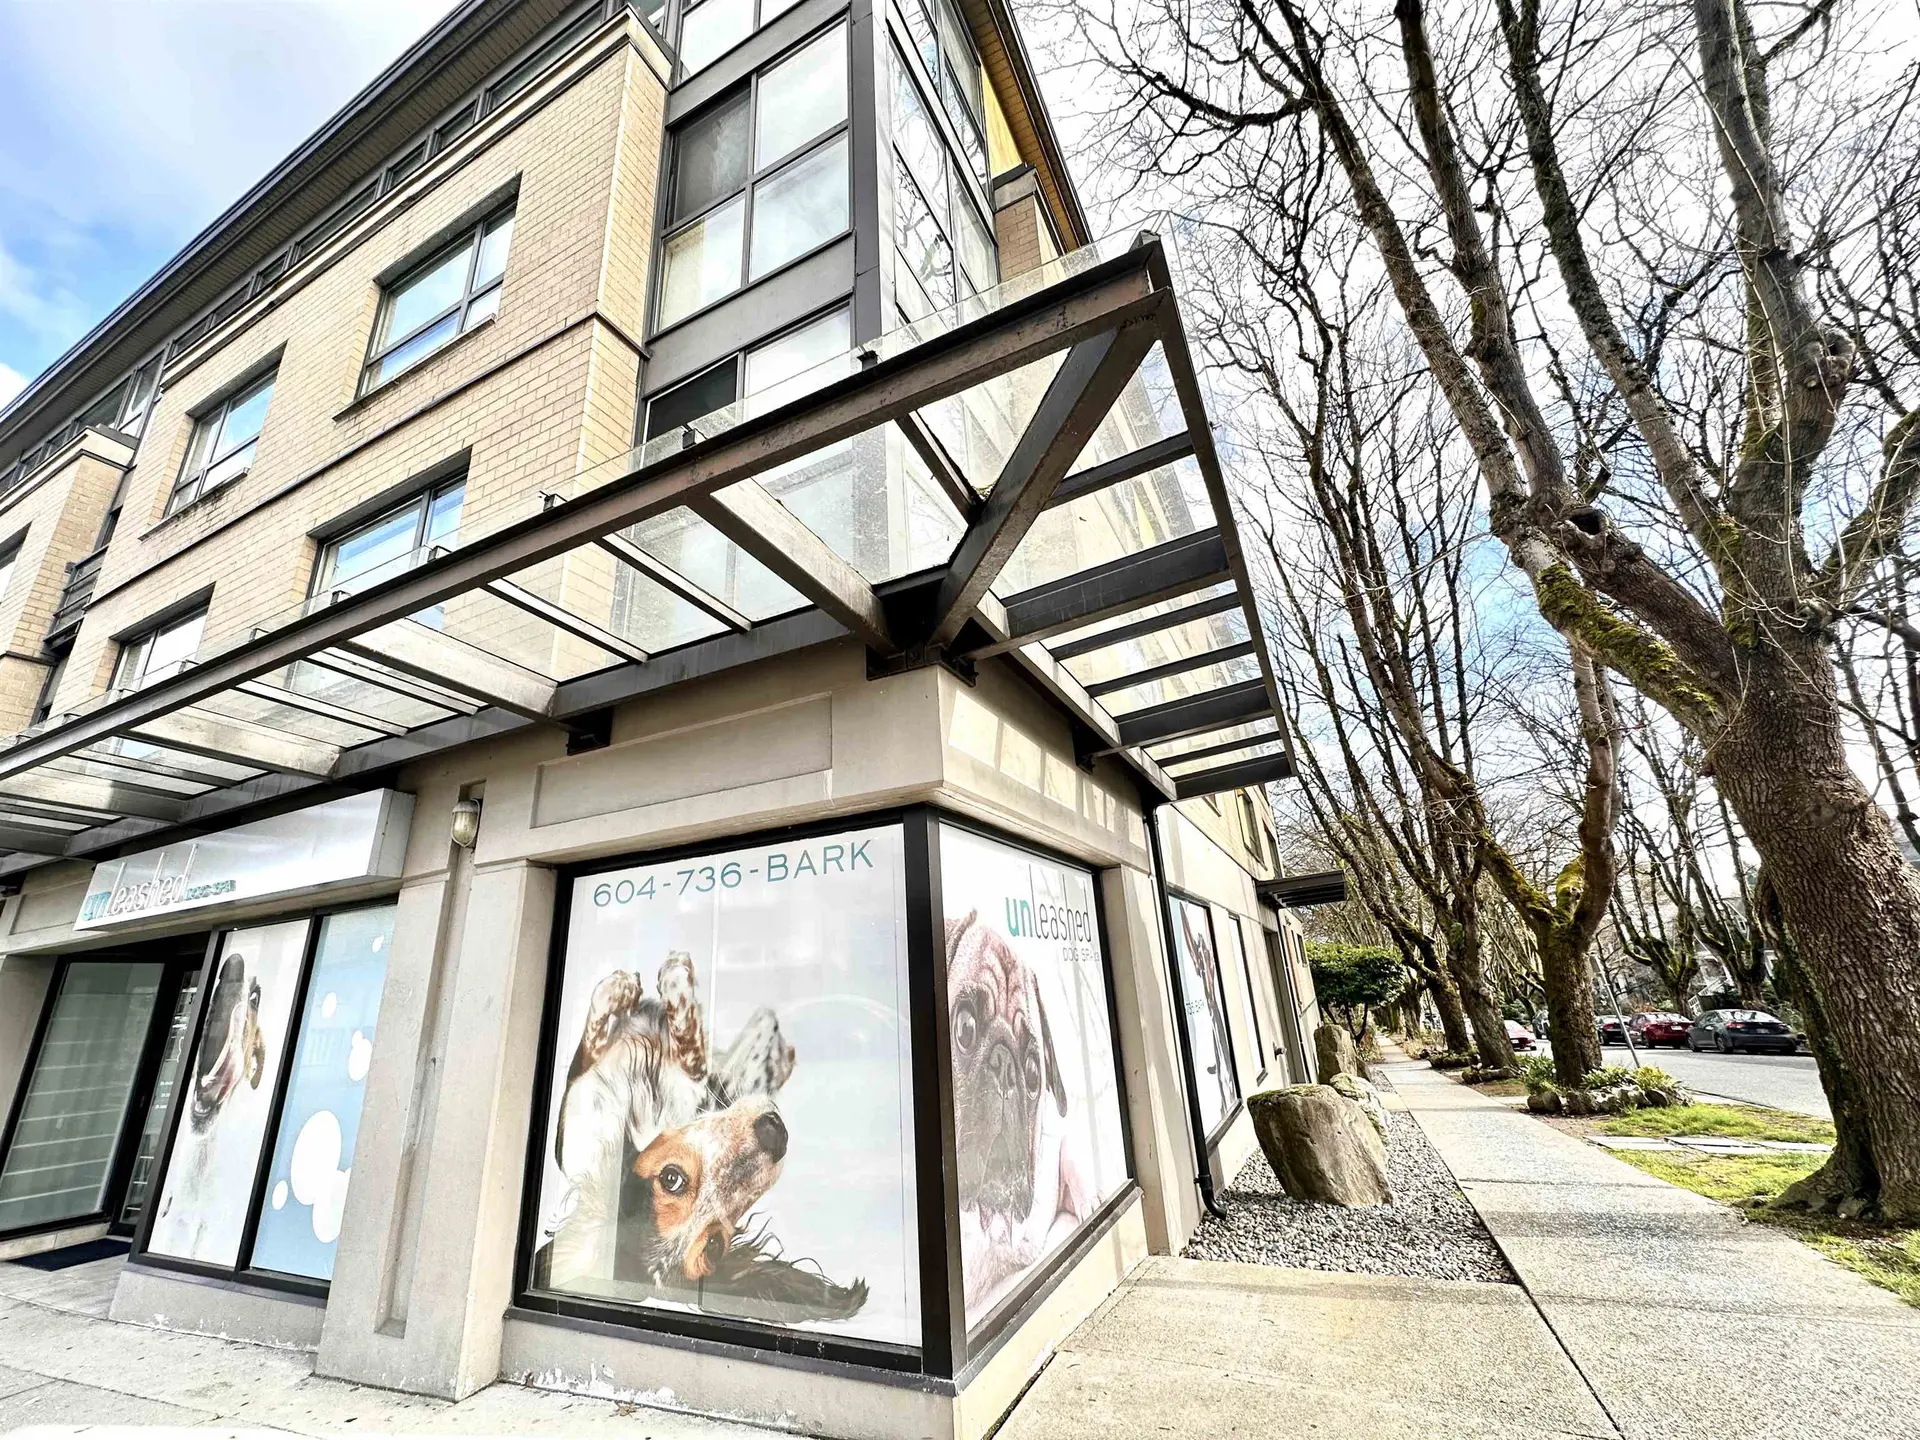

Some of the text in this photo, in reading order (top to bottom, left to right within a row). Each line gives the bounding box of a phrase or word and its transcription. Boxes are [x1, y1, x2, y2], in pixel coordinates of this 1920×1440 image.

[83, 844, 198, 921] unleashed
[593, 839, 874, 908] 604-736-BARK
[1005, 863, 1092, 943] unleashed
[1062, 947, 1079, 962] DOG
